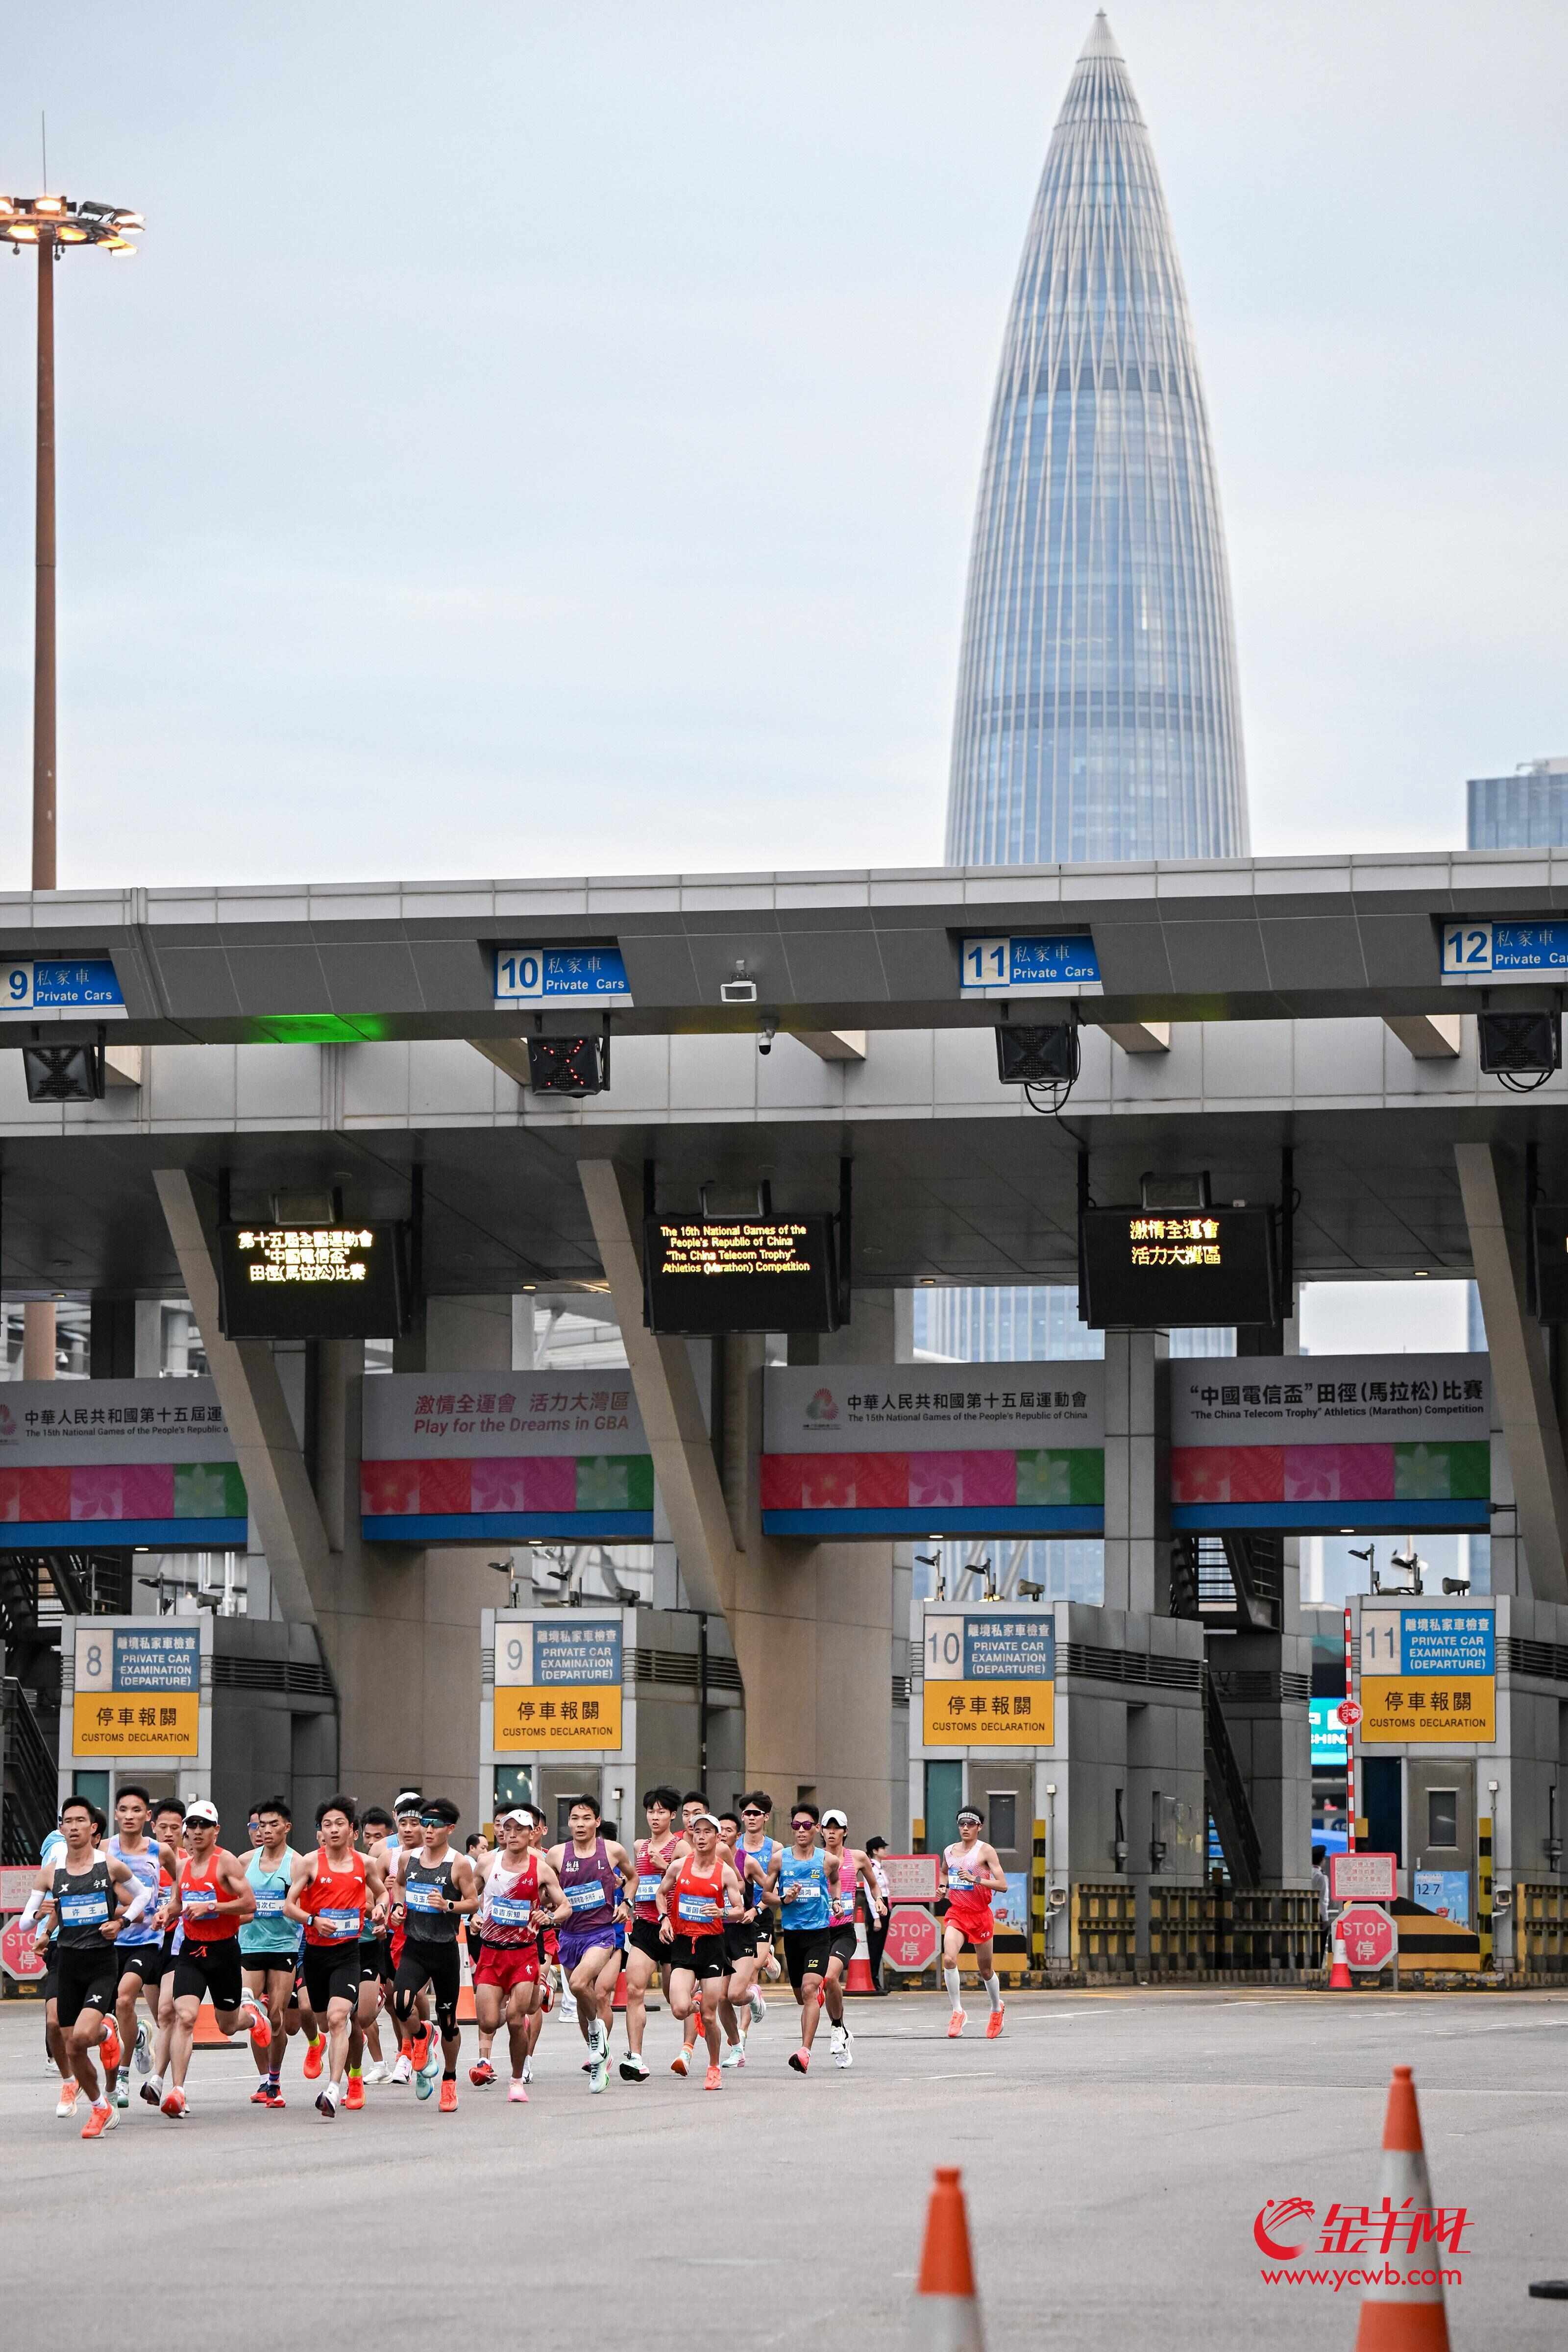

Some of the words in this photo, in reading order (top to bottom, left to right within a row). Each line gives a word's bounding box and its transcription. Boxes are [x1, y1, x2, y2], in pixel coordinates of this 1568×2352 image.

[1496, 929, 1554, 947] 私家車
[1015, 945, 1070, 962] 私家車
[1448, 931, 1488, 963] 12
[548, 956, 602, 974] 私家車
[968, 946, 1004, 978] 11
[1496, 954, 1541, 964] Private
[37, 968, 90, 986] 私家車
[502, 957, 538, 988] 10
[1013, 968, 1057, 979] Private
[1065, 966, 1094, 977] Cars
[9, 970, 28, 1000] 9
[546, 980, 588, 990] Private
[596, 979, 625, 989] Cars
[37, 991, 78, 1001] Private
[84, 990, 112, 1000] Cars
[661, 1226, 678, 1237] The
[703, 1225, 740, 1236] National
[743, 1225, 775, 1235] Games
[778, 1225, 789, 1235] of
[790, 1225, 807, 1234] the
[1129, 1219, 1220, 1240] 激情全運會
[238, 1230, 372, 1249] 第十五屆全國運動會
[671, 1237, 708, 1249] People's
[711, 1237, 751, 1249] Republic
[753, 1237, 763, 1246] of
[767, 1236, 793, 1246] China
[690, 1250, 716, 1261] China
[718, 1250, 757, 1260] Telecom
[1131, 1245, 1221, 1266] 活力大灣區
[662, 1263, 701, 1274] Athletics
[703, 1262, 753, 1274] (Marathon)
[756, 1261, 810, 1273] Competition
[414, 1393, 516, 1415] 激情全運會
[529, 1392, 630, 1413] 活力大灣區
[848, 1392, 1086, 1410] 中華人民共和國第十五屆運動會
[980, 1412, 1012, 1421] People's
[1016, 1412, 1051, 1421] Republic
[1214, 1410, 1241, 1419] China
[1244, 1409, 1283, 1418] Telecom
[1324, 1407, 1366, 1417] Athletics
[1369, 1405, 1421, 1416] (Marathon)
[1425, 1404, 1484, 1415] Competition
[152, 1426, 184, 1435] People's
[187, 1425, 221, 1434] Republic
[414, 1420, 448, 1437] Play
[453, 1419, 475, 1433] for
[480, 1418, 505, 1432] the
[510, 1417, 570, 1431] Dreams
[575, 1416, 588, 1430] in
[594, 1416, 629, 1430] GBA
[968, 1623, 1050, 1638] 離境私家車檢查
[1405, 1618, 1490, 1632] 離境私家車檢查
[117, 1637, 195, 1649] 離境私家車檢查
[537, 1630, 616, 1643] 離境私家車檢查
[1366, 1627, 1395, 1659] 11
[1411, 1637, 1456, 1646] PRIVATE
[1460, 1637, 1484, 1645] CAR
[543, 1648, 586, 1657] PRIVATE
[589, 1647, 611, 1656] CAR
[928, 1633, 959, 1664] 10
[974, 1642, 1017, 1651] PRIVATE
[1021, 1642, 1044, 1650] CAR
[1409, 1648, 1486, 1658] EXAMINATION
[87, 1645, 101, 1676] 8
[507, 1639, 522, 1670] 9
[972, 1654, 1046, 1663] EXAMINATION
[120, 1666, 191, 1674] EXAMINATION
[540, 1659, 613, 1668] EXAMINATION
[972, 1665, 1045, 1675] (DEPARTURE)
[1410, 1659, 1485, 1670] (DEPARTURE)
[121, 1676, 191, 1686] (DEPARTURE)
[541, 1669, 612, 1680] (DEPARTURE)
[948, 1696, 1031, 1715] 停車報關
[1384, 1691, 1471, 1712] 停車報關
[97, 1707, 176, 1726] 停車報關
[517, 1701, 599, 1720] 停車報關
[932, 1722, 977, 1731] CUSTOMS
[981, 1722, 1045, 1731] DECLARATION
[1370, 1718, 1415, 1727] CUSTOMS
[1420, 1718, 1486, 1727] DECLARATION
[503, 1728, 546, 1736] CUSTOMS
[551, 1727, 612, 1736] DECLARATION
[93, 1879, 108, 1888] 宁夏
[435, 1876, 447, 1885] 宁夏
[1417, 1884, 1429, 1894] 12
[1433, 1884, 1440, 1895] 7
[413, 1894, 429, 1904] 马玉
[686, 1906, 702, 1914] 董国
[888, 1923, 932, 1937] STOP
[1343, 1922, 1387, 1936] STOP
[6, 1934, 36, 1946] STO
[900, 1941, 920, 1961] 停
[1356, 1940, 1375, 1961] 停
[19, 1950, 38, 1970] 停
